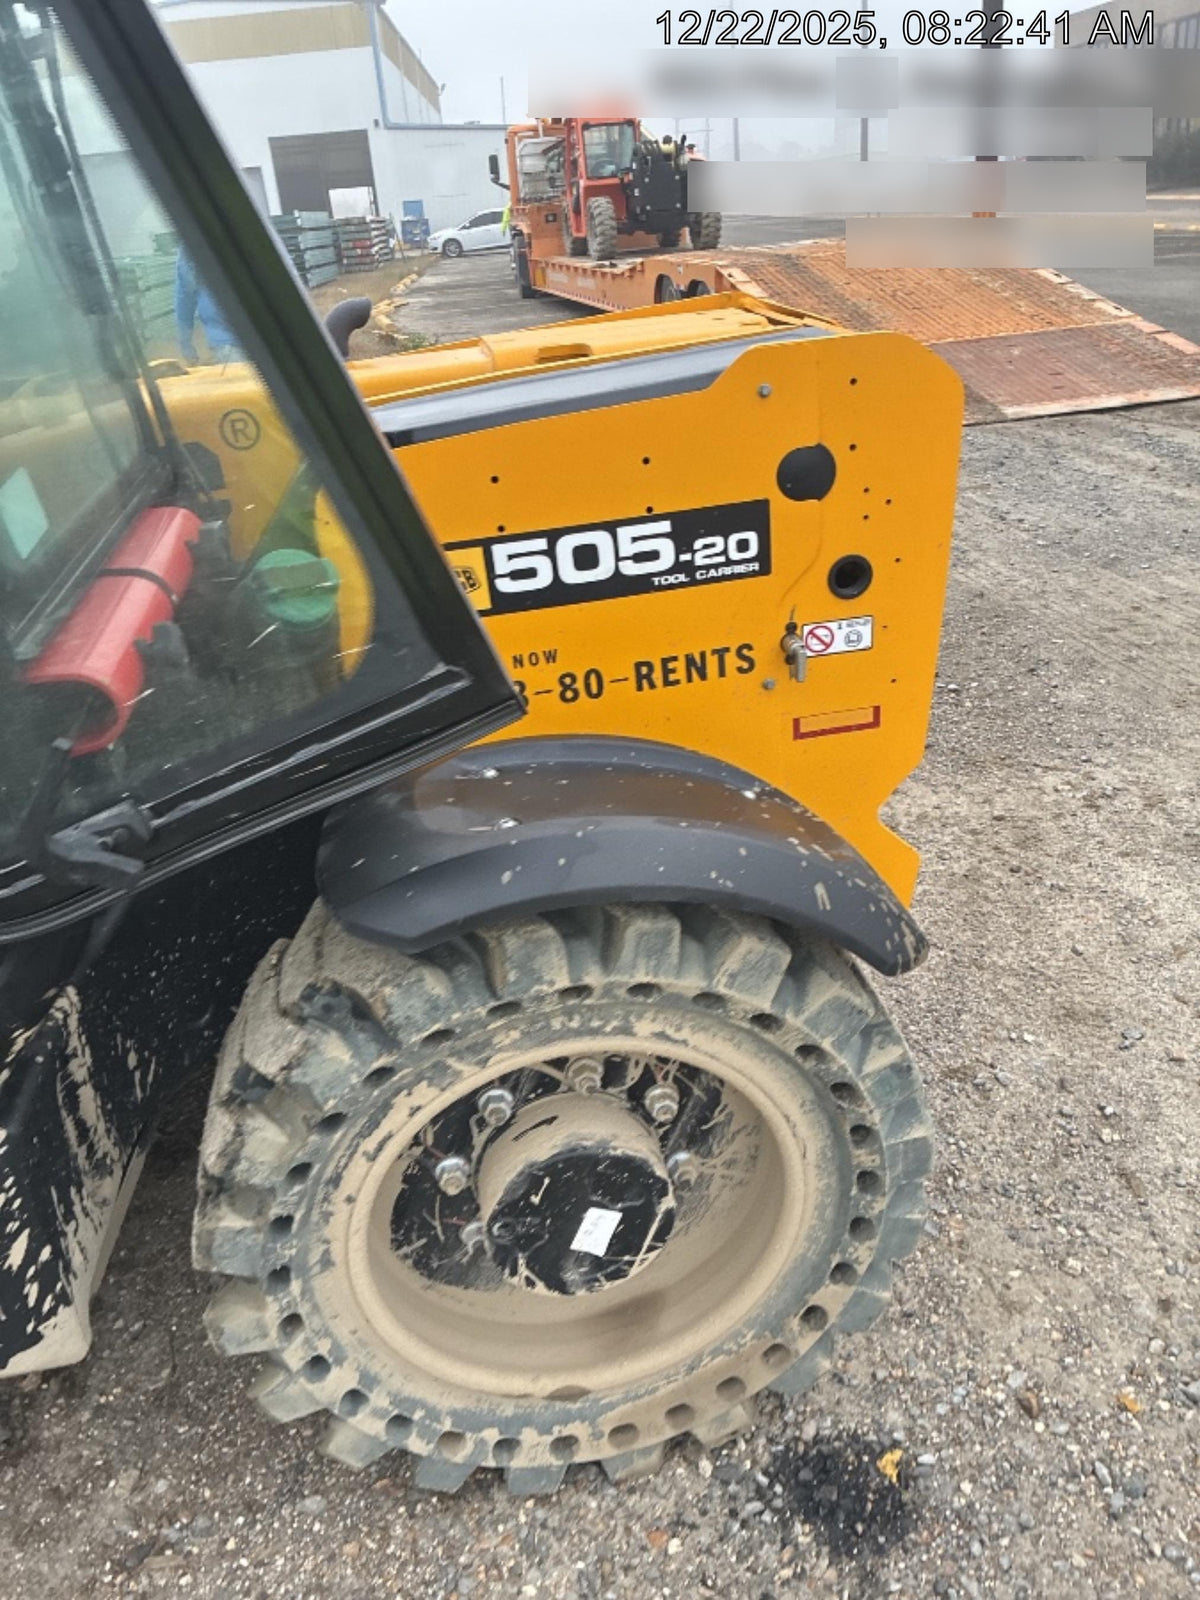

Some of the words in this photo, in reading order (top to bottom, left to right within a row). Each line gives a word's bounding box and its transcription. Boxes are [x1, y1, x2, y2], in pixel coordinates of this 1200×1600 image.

[491, 520, 759, 593] 505-20
[652, 573, 690, 586] TOOL
[695, 562, 760, 580] CARRIER
[513, 649, 558, 668] NOW
